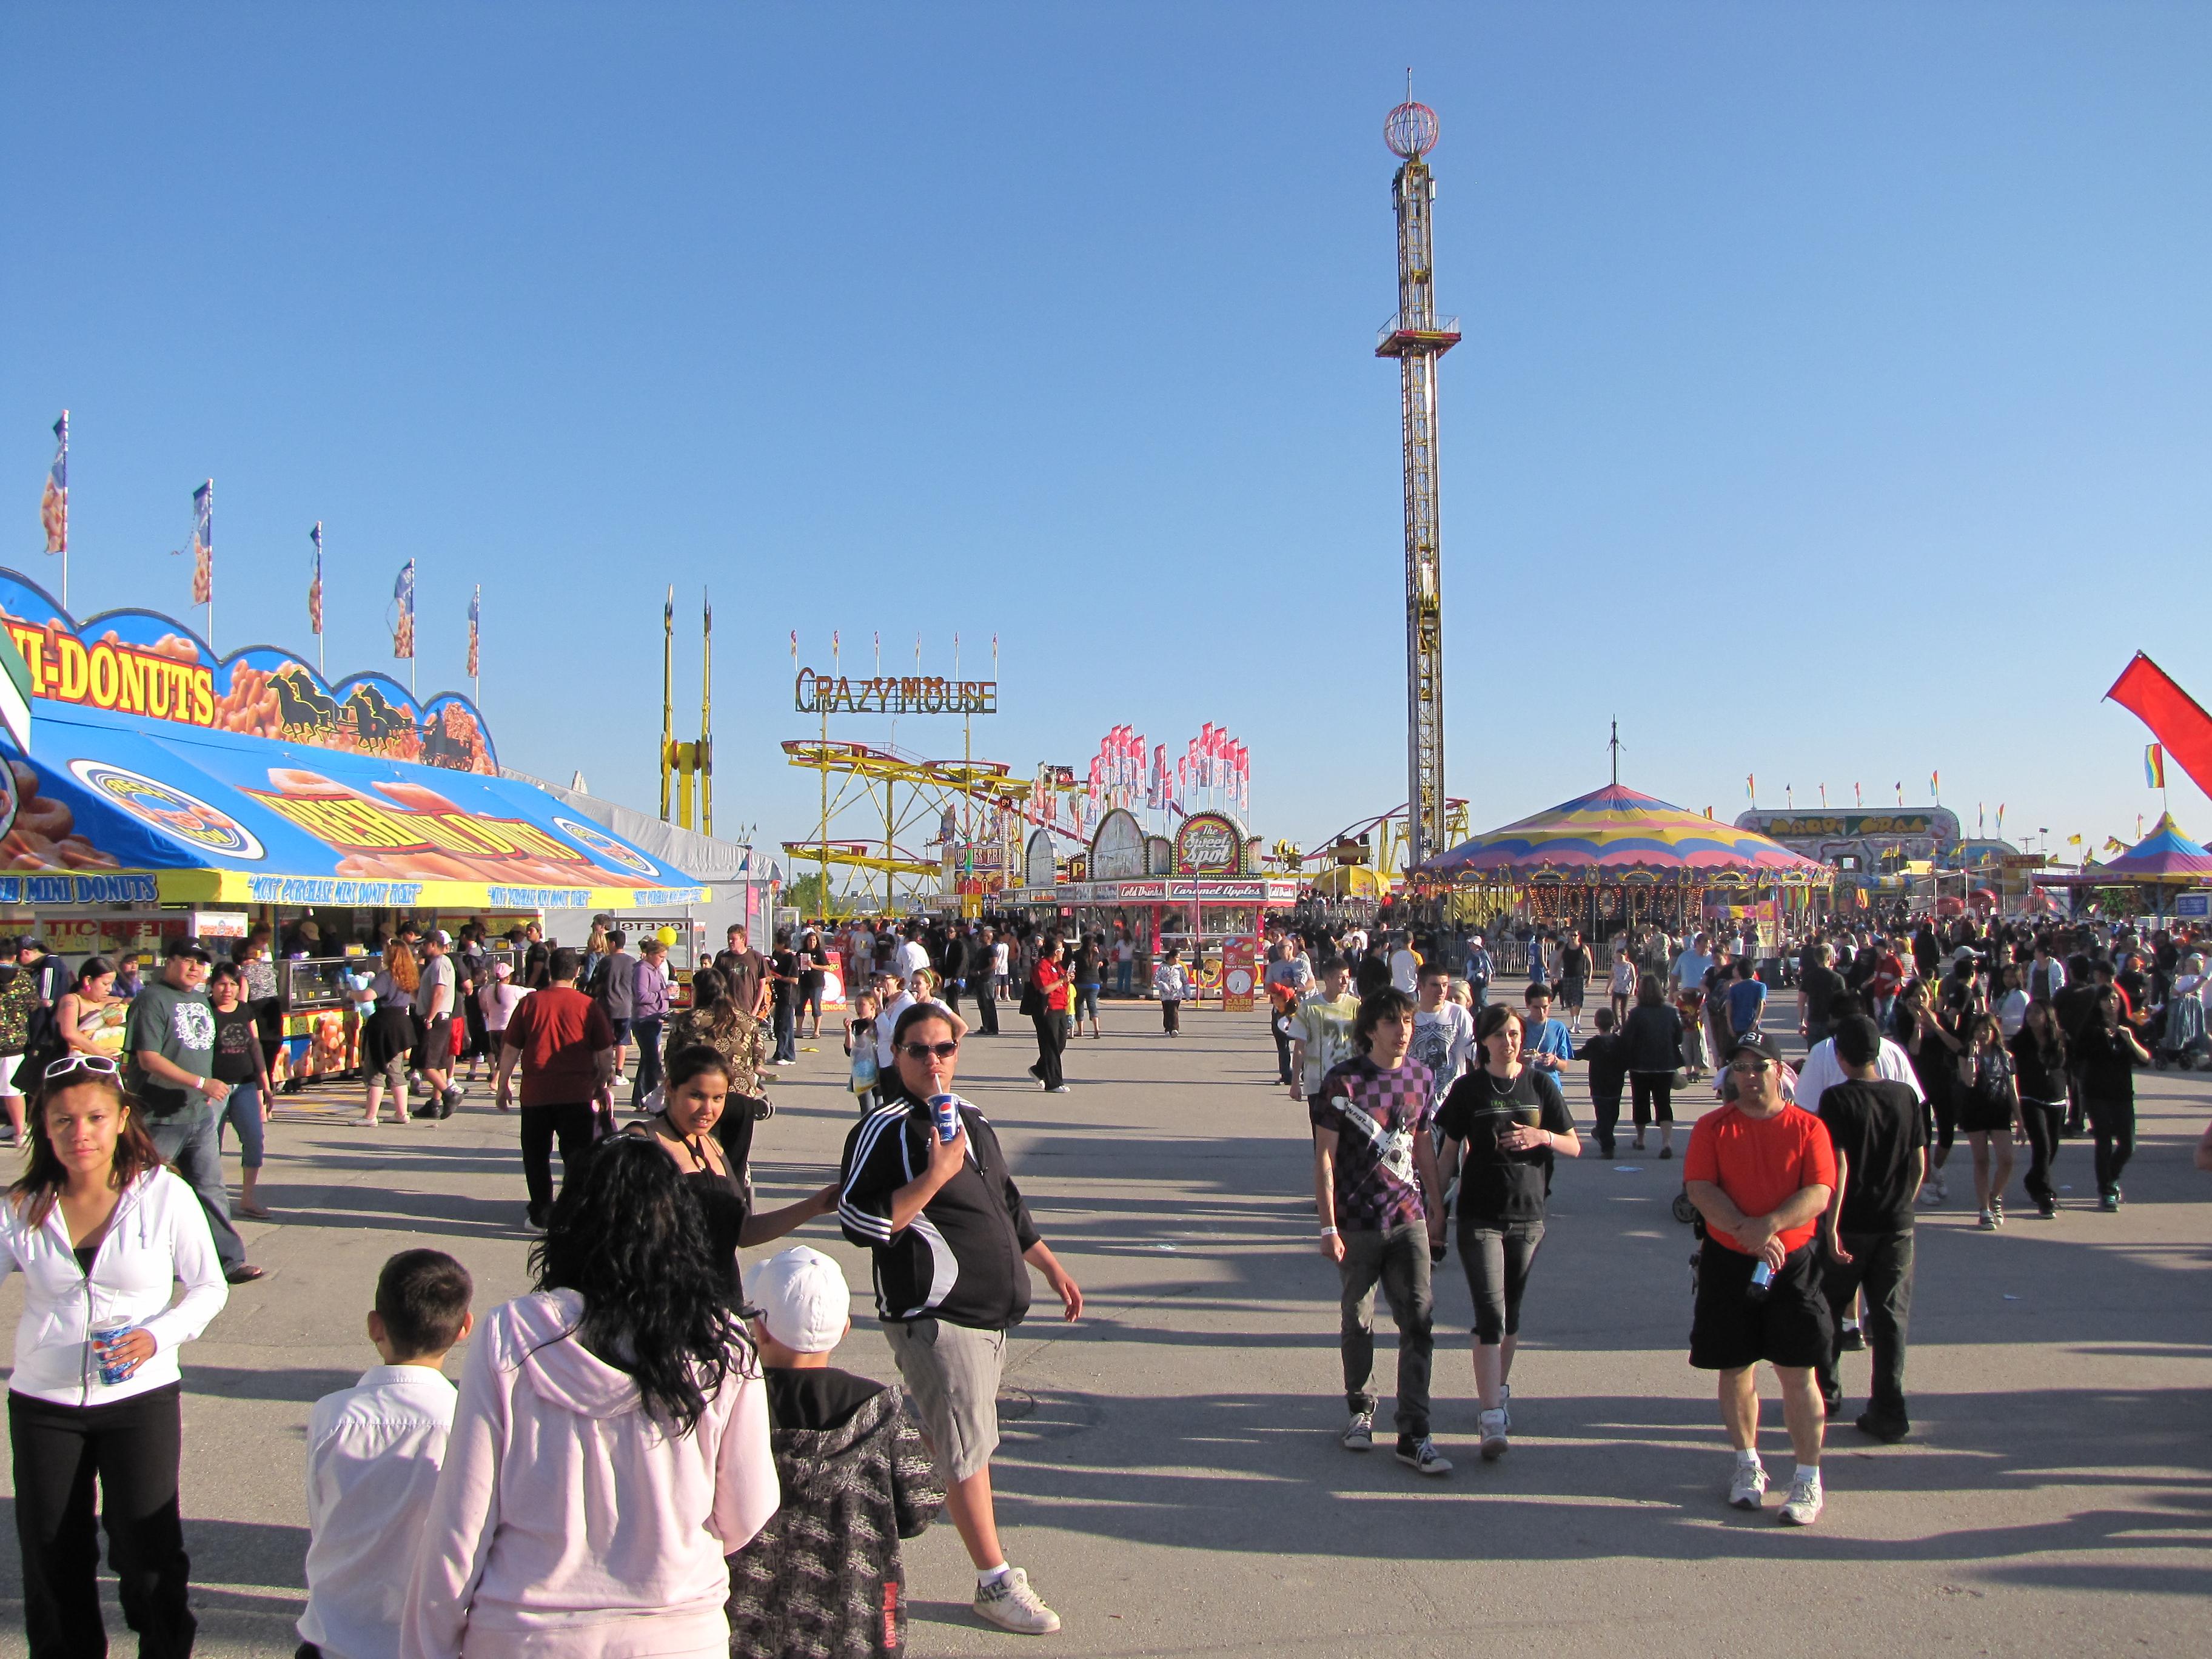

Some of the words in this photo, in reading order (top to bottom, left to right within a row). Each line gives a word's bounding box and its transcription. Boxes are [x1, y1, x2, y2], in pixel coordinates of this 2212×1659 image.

[796, 667, 897, 713] CRAZY
[901, 677, 996, 714] MOUSE
[244, 791, 427, 847] FRESH
[1202, 825, 1218, 835] The
[1184, 831, 1231, 848] Sweet
[957, 848, 983, 866] WGS
[25, 876, 73, 903] MINI
[75, 874, 158, 903] DONUTS
[1121, 886, 1138, 897] Cold
[1138, 886, 1164, 897] Drinks
[1173, 886, 1221, 895] Caramel
[1222, 886, 1261, 896] Apples
[1761, 902, 1773, 919] 4
